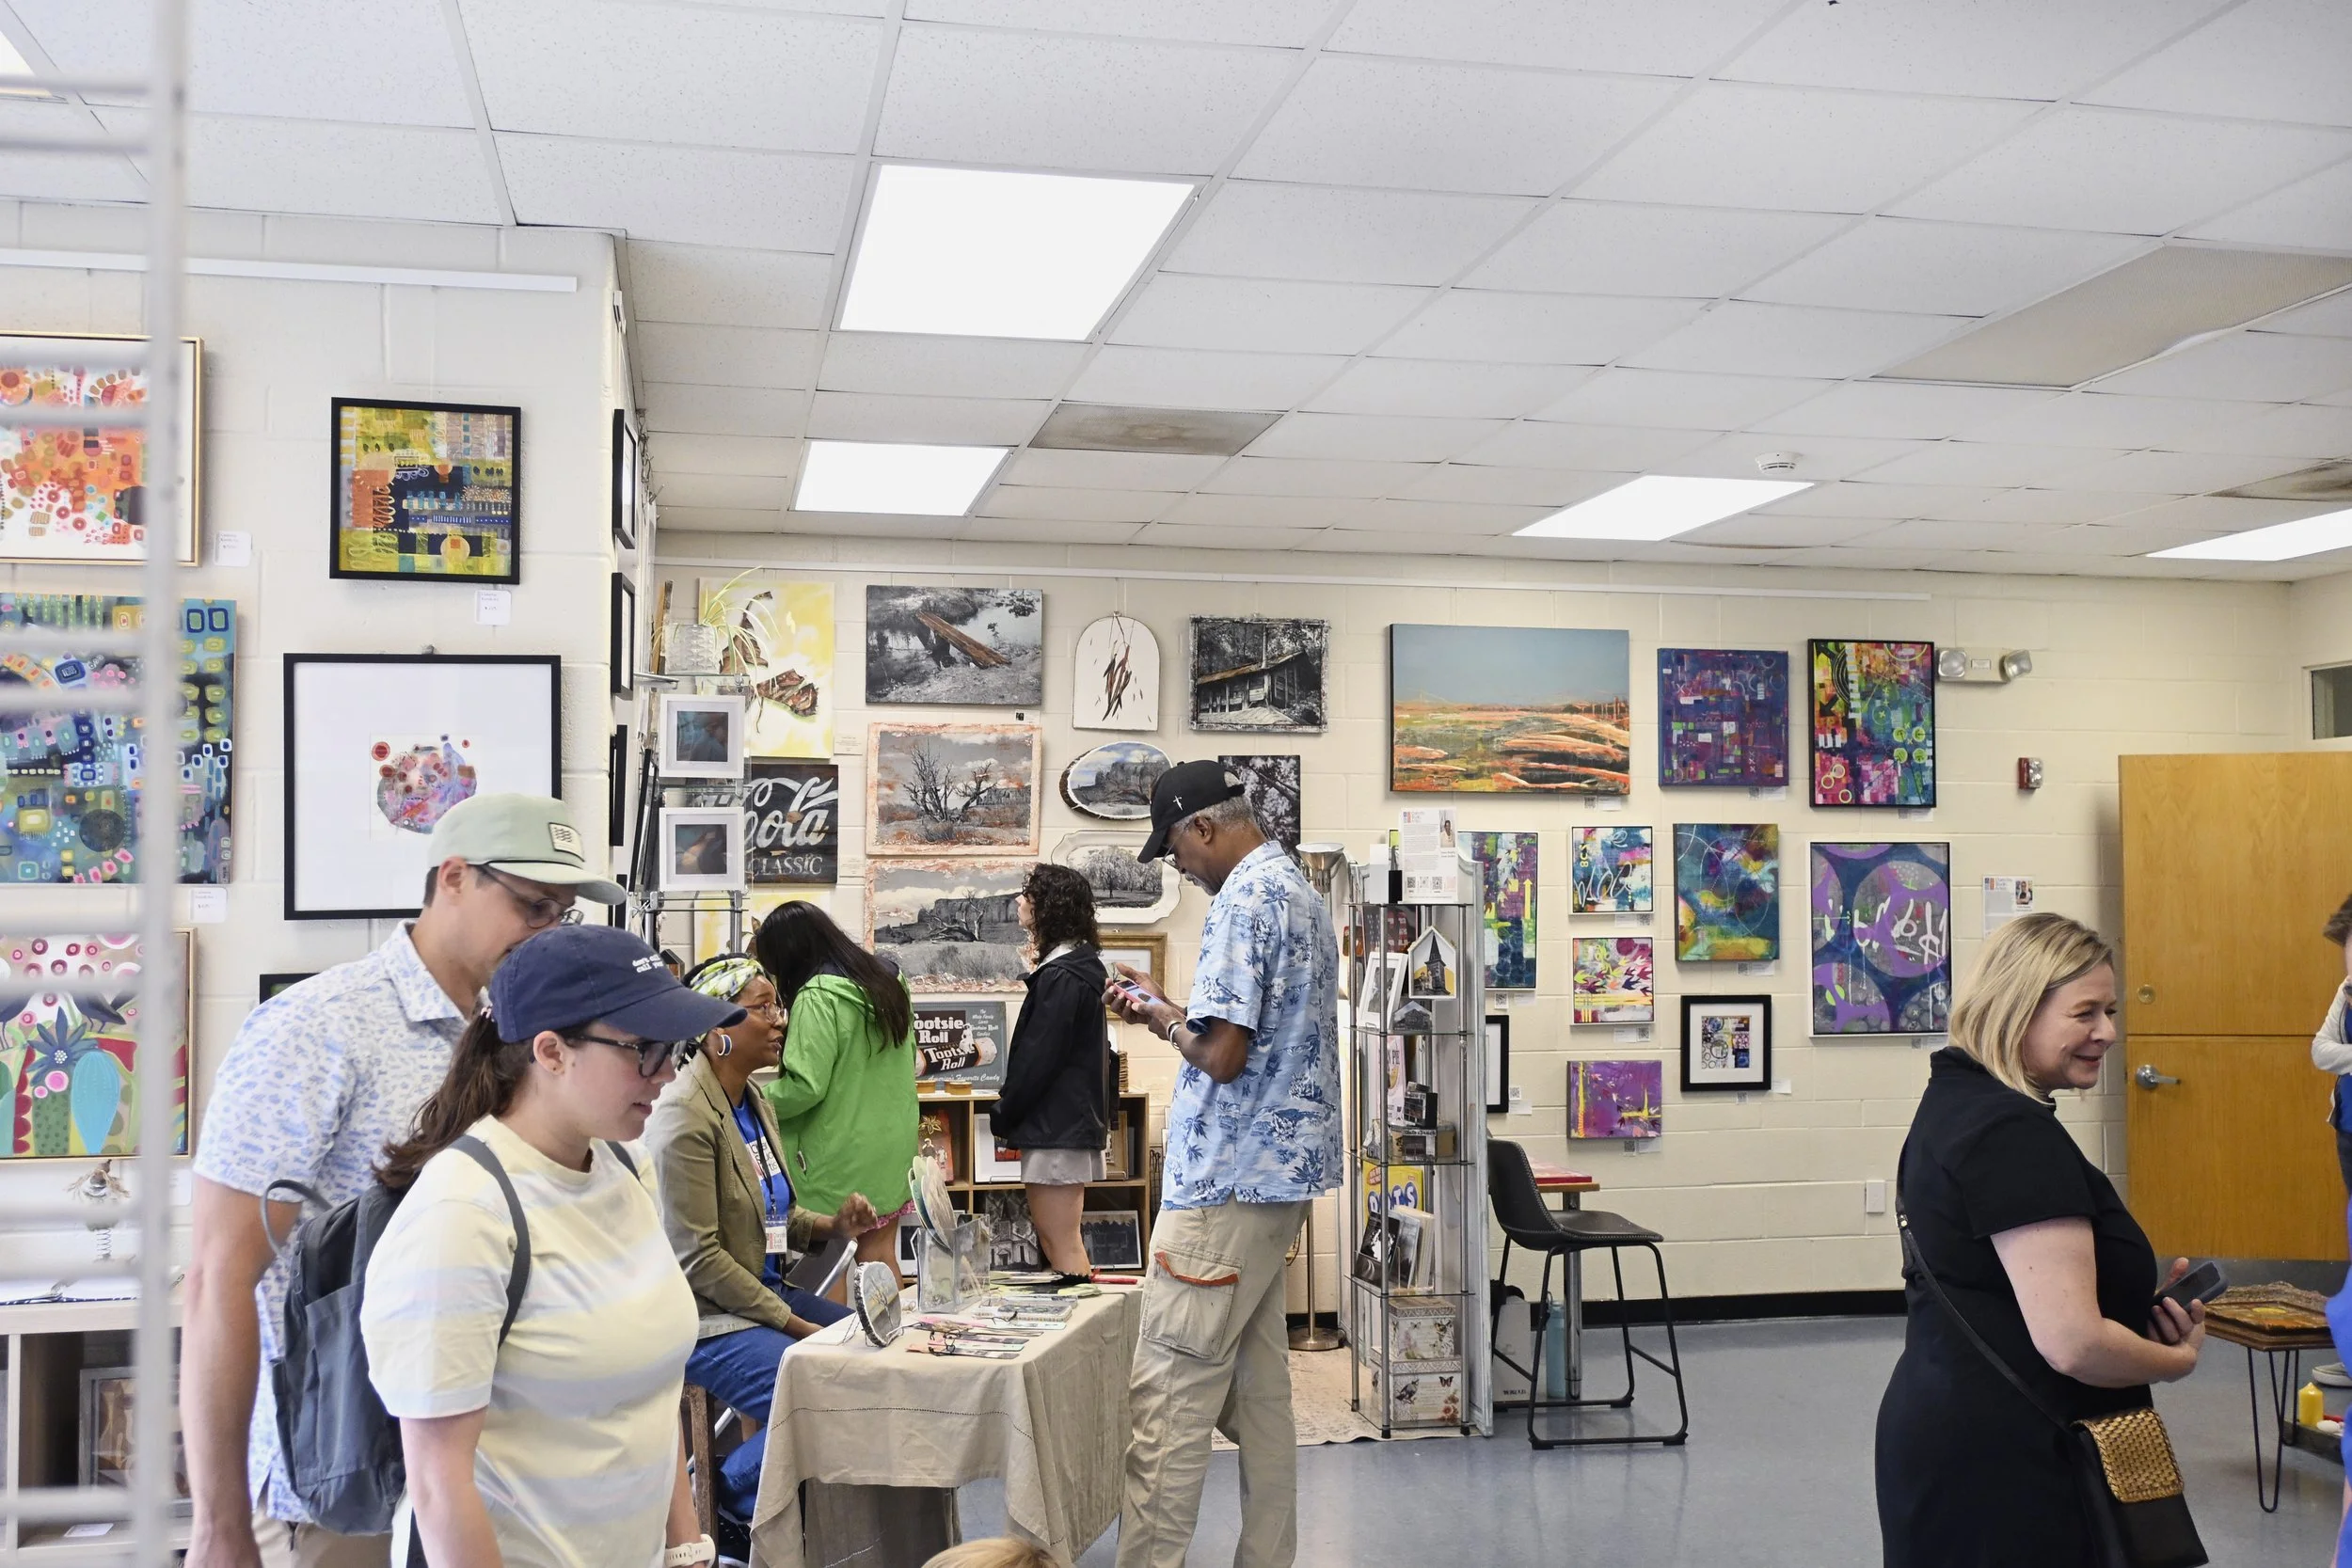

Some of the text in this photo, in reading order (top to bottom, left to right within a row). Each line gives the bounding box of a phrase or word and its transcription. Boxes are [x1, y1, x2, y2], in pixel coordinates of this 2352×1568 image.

[747, 853, 823, 877] CLASSIC
[914, 1013, 964, 1030] ootsie
[918, 1030, 949, 1044] Roll
[940, 1056, 966, 1071] Roll
[980, 1073, 1000, 1082] Candy
